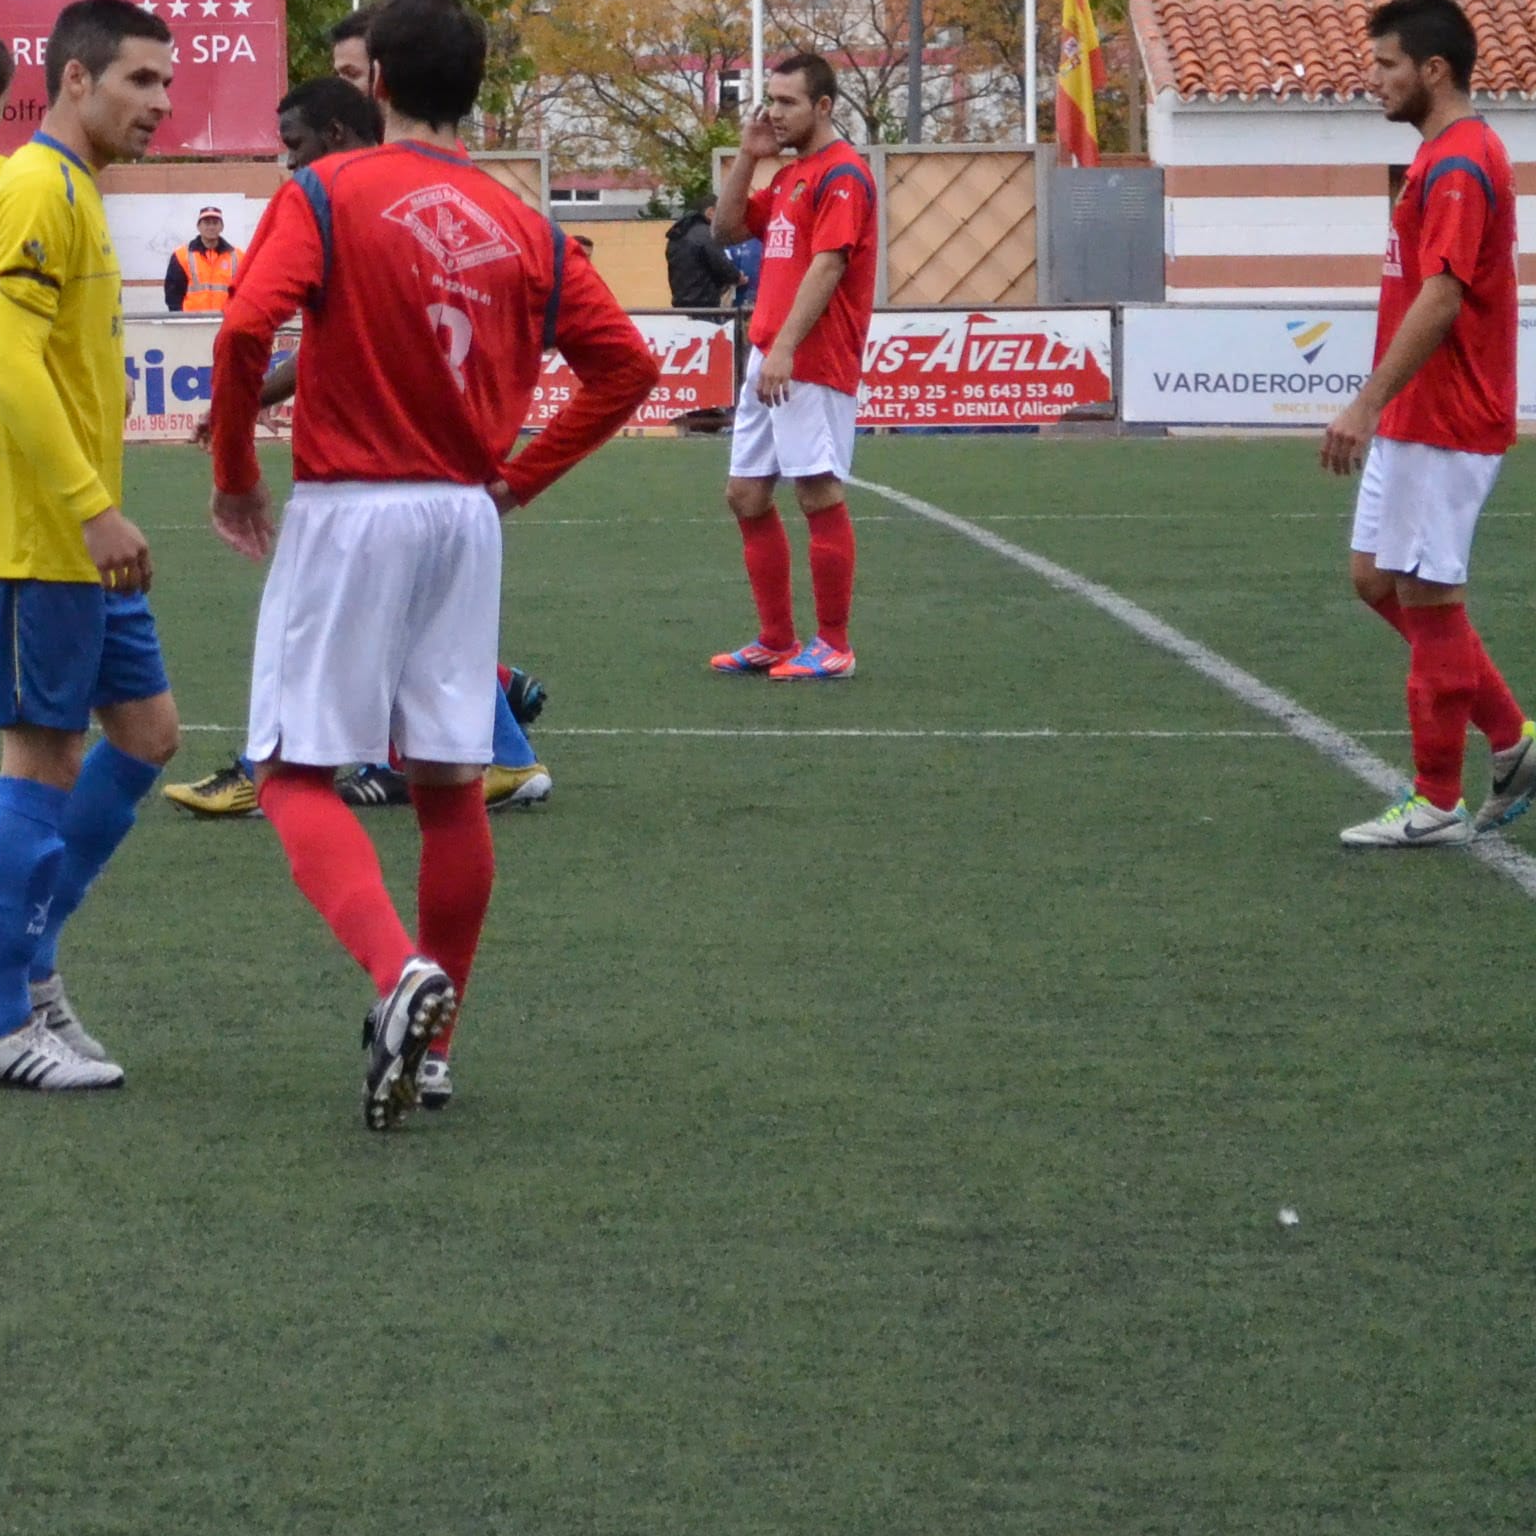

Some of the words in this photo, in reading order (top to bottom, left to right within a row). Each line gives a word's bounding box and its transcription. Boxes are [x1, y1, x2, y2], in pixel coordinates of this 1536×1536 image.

[192, 34, 257, 64] SPA
[1154, 372, 1372, 394] VARADEROPOR
[533, 387, 544, 401] 9
[548, 387, 570, 401] 25
[649, 387, 671, 402] 53
[675, 387, 697, 402] 40
[898, 384, 921, 400] 39
[925, 384, 947, 400] 25
[962, 384, 985, 399] 96
[989, 384, 1022, 399] 643
[1026, 383, 1048, 398] 53
[1052, 383, 1074, 398] 40
[914, 403, 937, 418] 35
[953, 402, 1009, 417] DENIA
